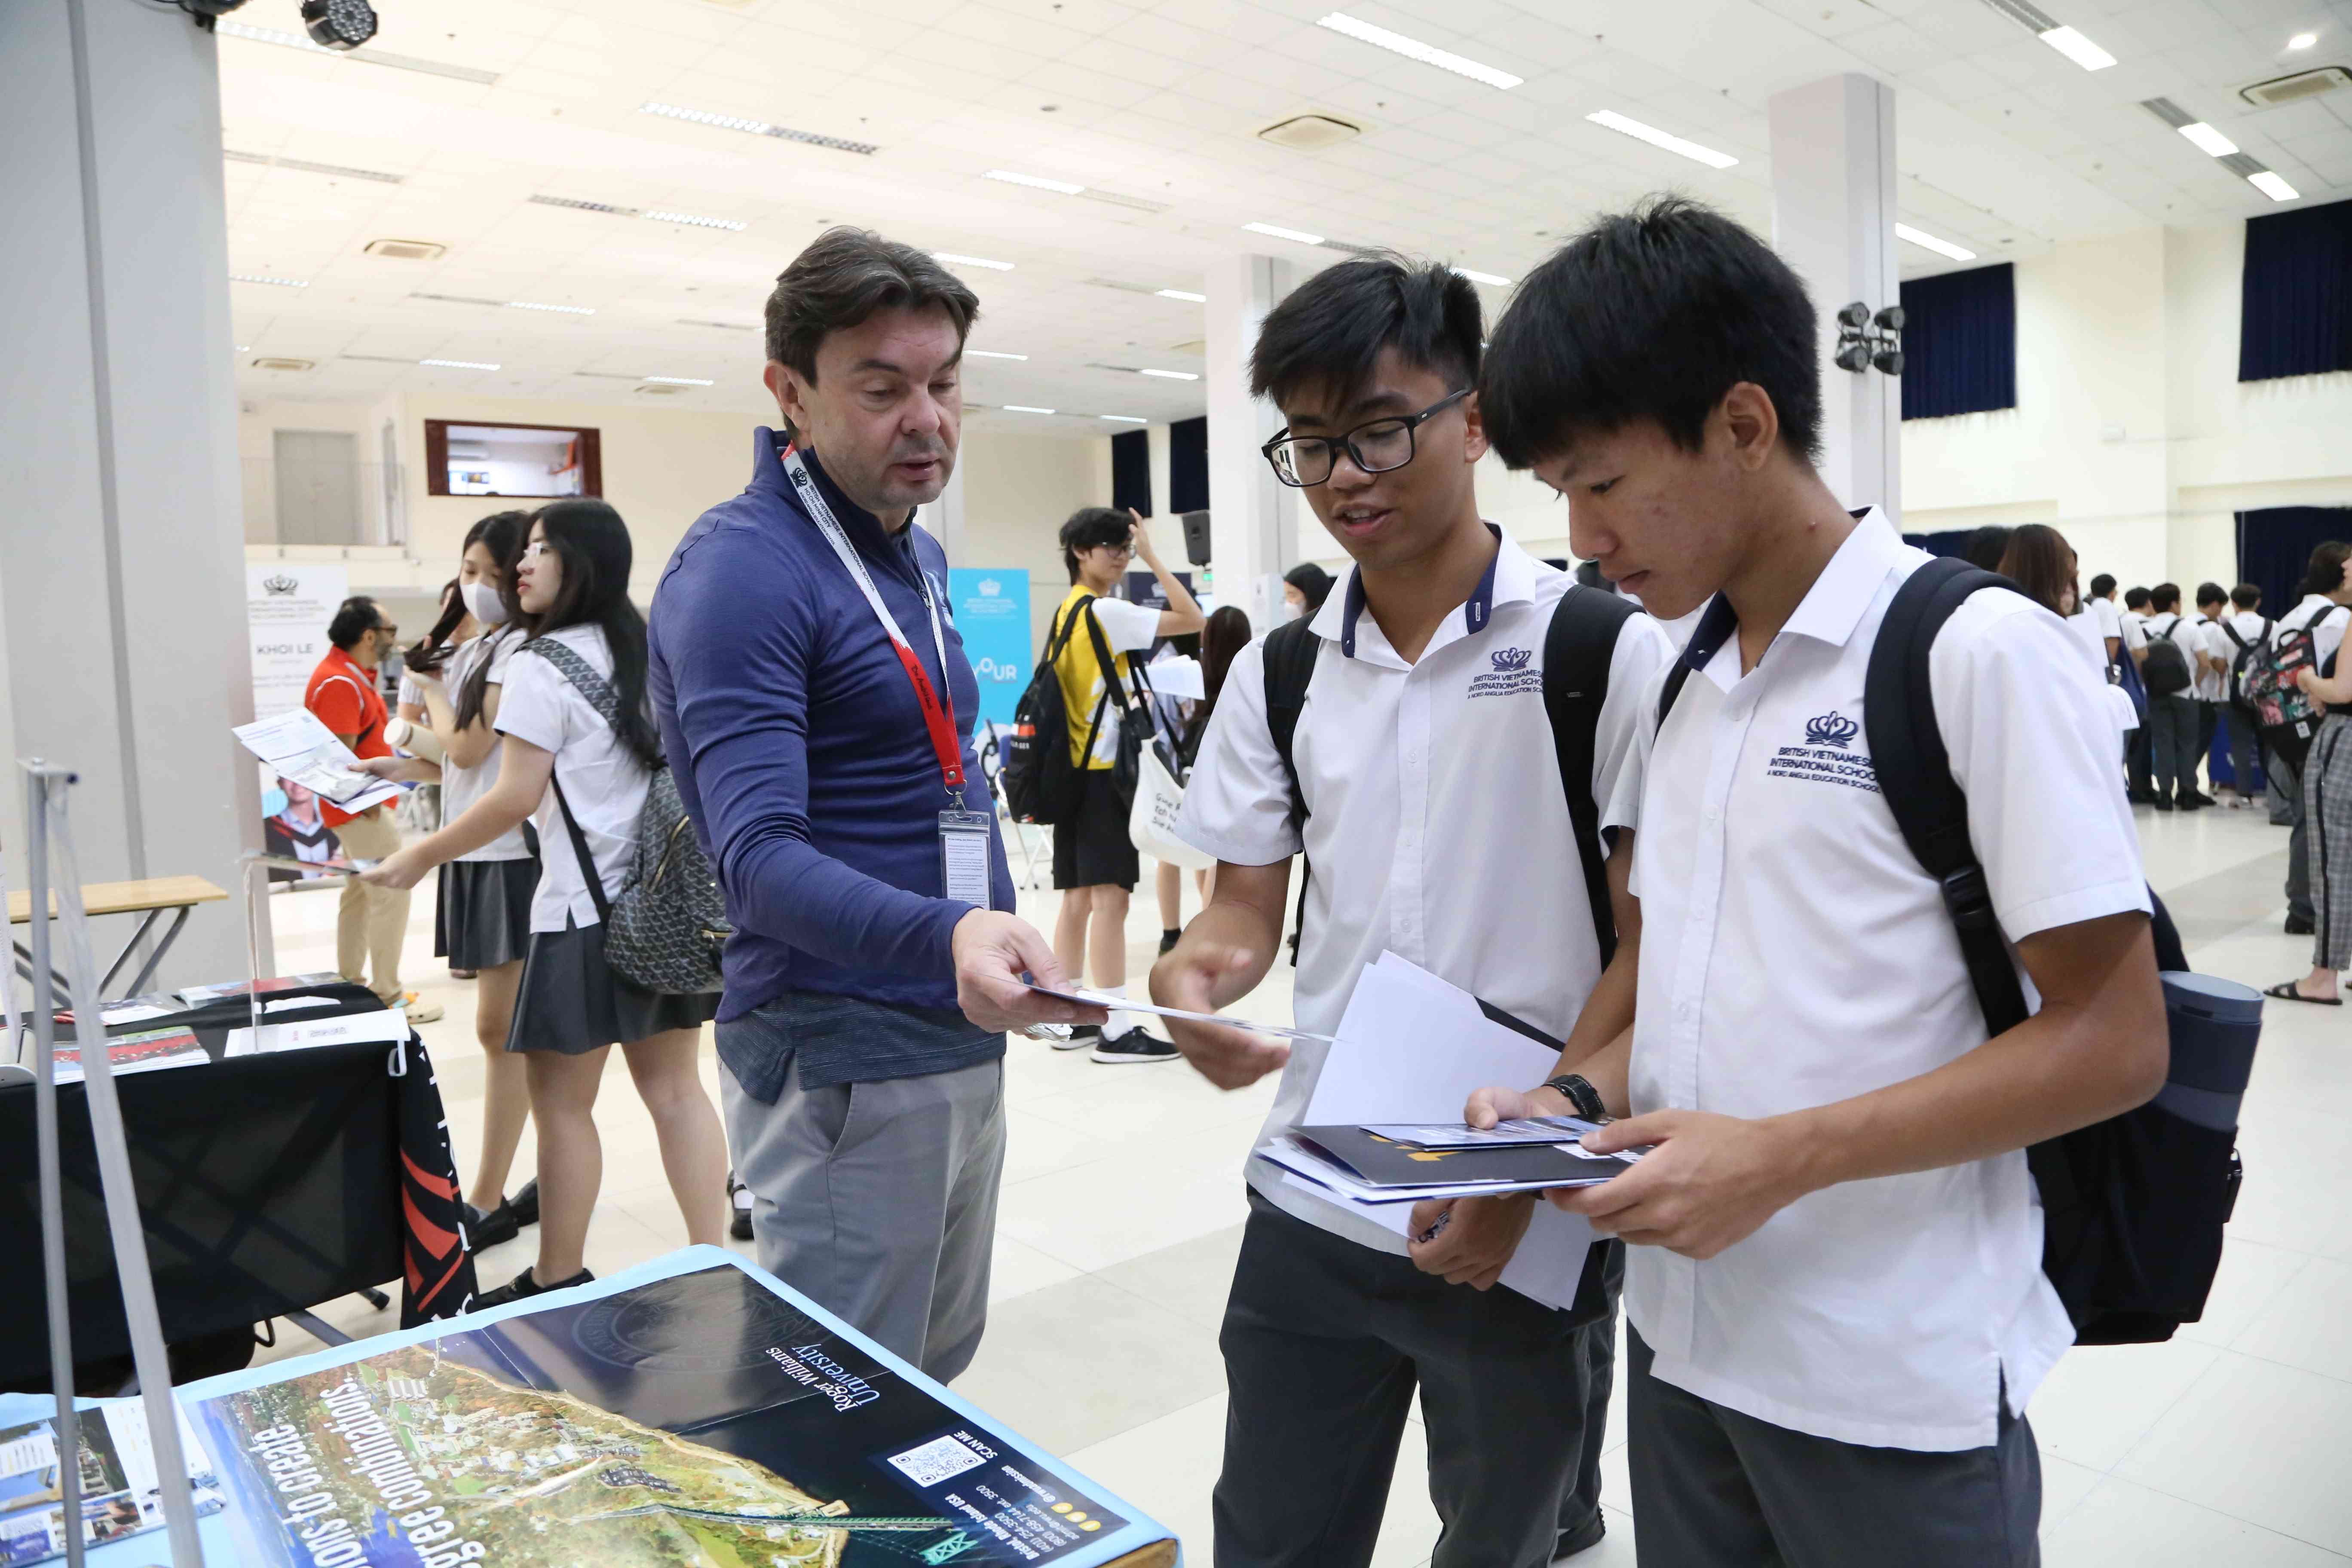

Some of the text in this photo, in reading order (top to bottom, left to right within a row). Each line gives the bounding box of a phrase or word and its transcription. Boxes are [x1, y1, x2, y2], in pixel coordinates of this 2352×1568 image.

[814, 503, 823, 517] MINH
[822, 517, 831, 527] CITY
[819, 501, 840, 533] VIETNAMESE
[838, 531, 863, 571] INTERNATIONAL
[862, 571, 876, 591] SCHOOL
[1468, 678, 1544, 692] INTERNATIONAL SCHO
[1473, 669, 1543, 683] BRITISH VIETNAMES
[1504, 687, 1531, 695] EDUCATION
[1778, 747, 1810, 758] BRITISH
[1770, 758, 1876, 781] INTERNATIONAL SCHOO
[1812, 774, 1849, 786] EDUCATION
[1851, 780, 1881, 793] SCHOOL
[766, 1348, 819, 1385] Williams
[792, 1344, 880, 1406] University
[813, 1382, 858, 1412] Roger
[248, 1424, 322, 1492] create
[320, 1377, 432, 1510] combinations.
[953, 1430, 998, 1458] SCAN ME
[976, 1485, 998, 1500] 3500
[1001, 1465, 1056, 1503] @rwuadmission
[282, 1492, 337, 1525] to
[945, 1493, 1040, 1560] Bristol, Rhode Island USA
[995, 1512, 1054, 1553] (401) 254-3500
